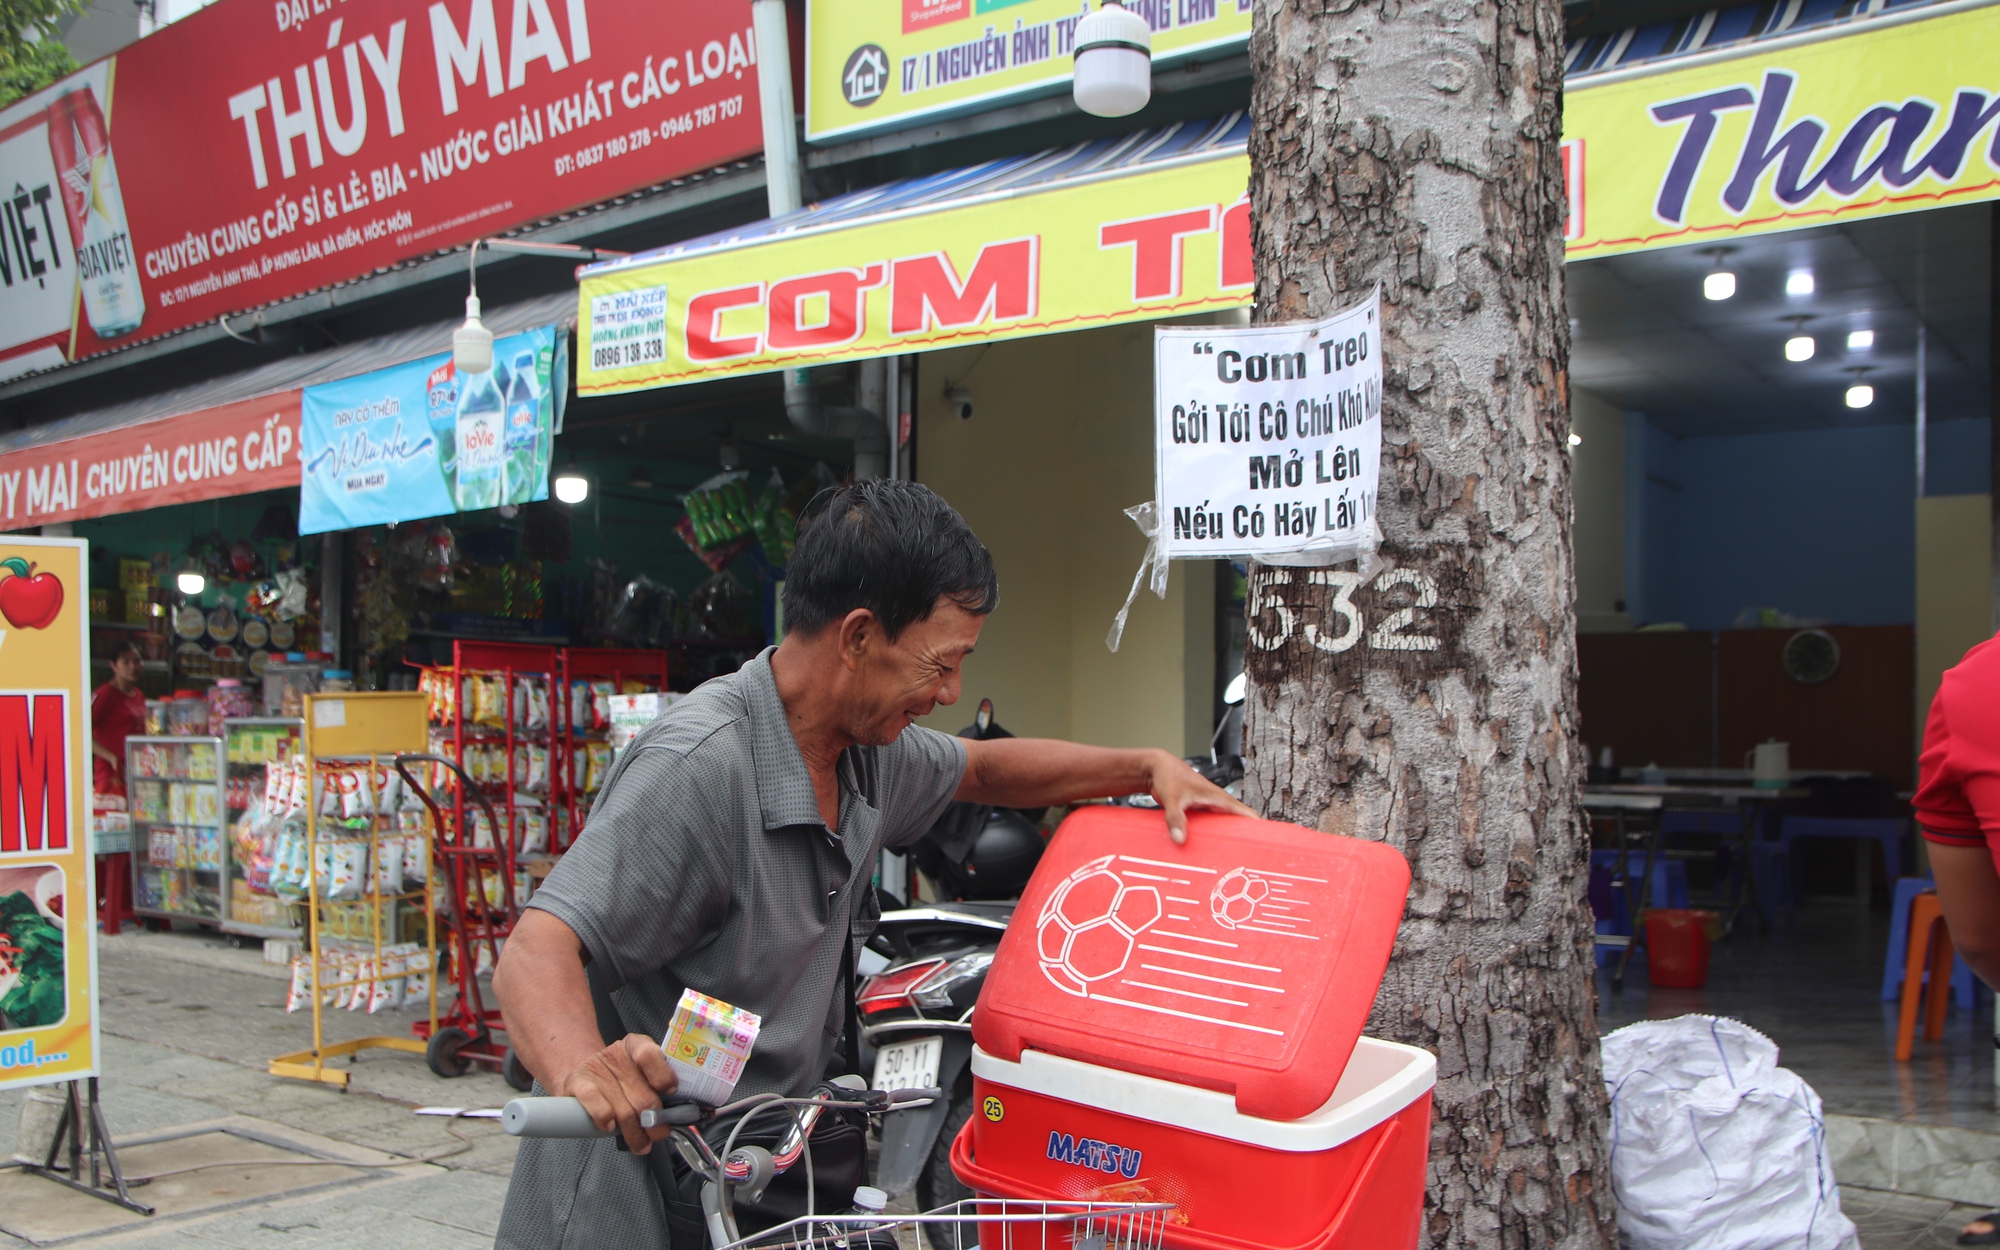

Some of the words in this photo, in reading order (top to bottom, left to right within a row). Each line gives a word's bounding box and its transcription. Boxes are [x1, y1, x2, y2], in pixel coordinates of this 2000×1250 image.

[936, 28, 1007, 84] NGUYỄN
[1012, 19, 1050, 66] ẢNH
[228, 17, 407, 190] THÚY
[428, 0, 591, 117] MAI
[145, 230, 211, 279] CHUYÊN
[210, 215, 262, 257] CUNG
[262, 193, 300, 239] CẤP
[323, 187, 338, 219] &
[338, 170, 369, 213] LẺ:
[371, 162, 408, 202] BIA
[420, 129, 490, 184] NƯỚC
[493, 104, 543, 156] GIẢI
[546, 79, 614, 138] KHÁT
[621, 55, 681, 109] CÁC
[685, 27, 757, 87] LOẠI
[554, 154, 575, 177] ĐT:
[576, 143, 604, 169] 0837
[606, 136, 628, 159] 180
[629, 127, 651, 151] 278
[660, 112, 693, 140] 0946
[694, 104, 717, 128] 787
[719, 94, 743, 121] 707
[274, 248, 301, 272] HƯNG
[363, 217, 387, 242] HÓC
[387, 210, 413, 234] MÔN
[685, 233, 1040, 362] CƠM
[594, 346, 620, 369] 0896
[625, 342, 641, 364] 138
[644, 338, 663, 359] 338
[356, 402, 370, 424] CÓ
[1171, 399, 1208, 444] Gởi
[1215, 402, 1250, 444] Tới
[1259, 400, 1288, 442] Cô
[1297, 394, 1333, 438] Chú
[1338, 383, 1363, 431] Khó
[27, 459, 79, 518] MAI
[86, 443, 169, 499] CHUYÊN
[173, 436, 238, 483] CUNG
[242, 413, 293, 472] CẤP
[1249, 448, 1304, 490] Mở
[1316, 444, 1361, 485] Lên
[1174, 500, 1223, 541] Nếu
[1232, 504, 1265, 538] Có
[1274, 501, 1317, 538] Hãy
[1250, 567, 1442, 653] 532
[985, 1100, 1001, 1118] 25
[1047, 1130, 1142, 1179] MATSU
